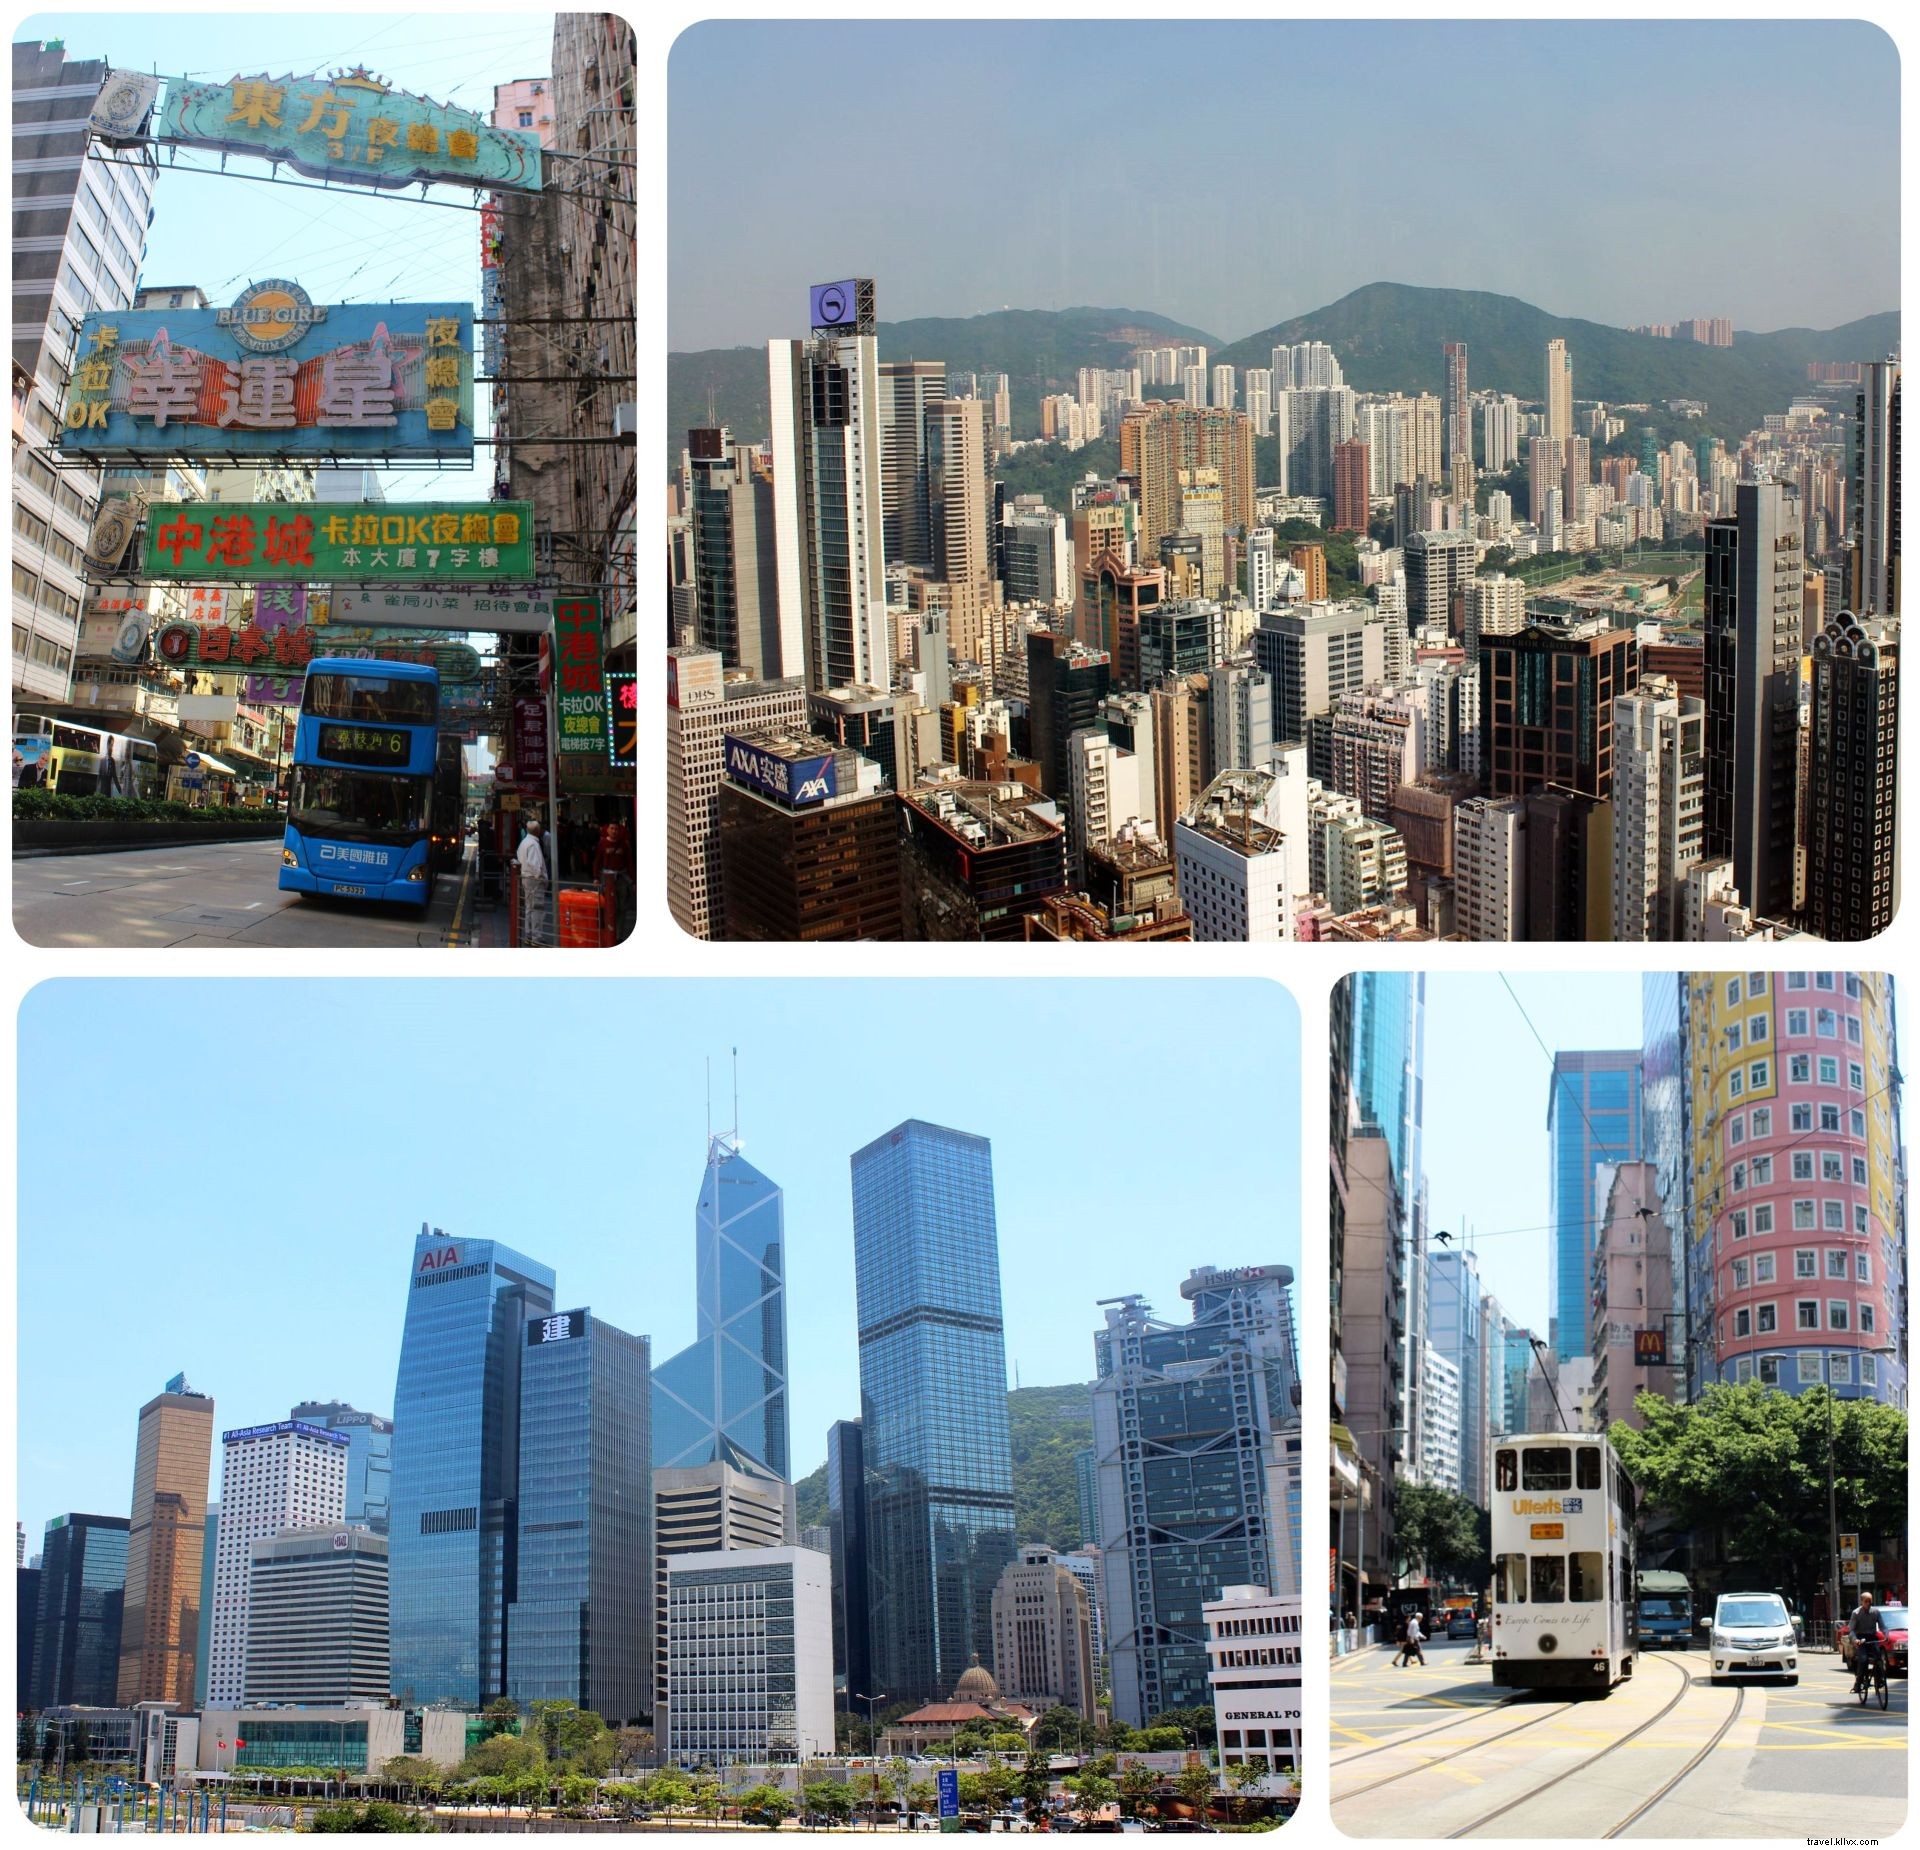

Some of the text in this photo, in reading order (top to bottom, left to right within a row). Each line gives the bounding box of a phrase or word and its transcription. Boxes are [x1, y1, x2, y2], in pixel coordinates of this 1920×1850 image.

[224, 81, 356, 139] 東方
[216, 305, 329, 326] BLUE GIRL
[66, 325, 120, 430] 卡拉OK
[424, 317, 461, 431] 夜總會
[321, 513, 520, 545] 卡拉OK夜總會
[158, 513, 316, 567] 中港城
[473, 598, 550, 615] 招待會員
[197, 622, 316, 666] 日本城
[558, 602, 601, 693] 中港城
[559, 696, 604, 714] 卡拉OK
[688, 689, 715, 703] DBS
[564, 716, 601, 734] 夜總會
[390, 734, 401, 752] 6
[560, 737, 606, 751] 電梯按7字
[731, 746, 760, 778] AXA
[795, 778, 829, 800] AXA
[337, 847, 389, 866] 美國雅培
[420, 1246, 458, 1271] AIA
[1204, 1270, 1242, 1285] HSBC
[542, 1315, 570, 1342] 建
[252, 1422, 277, 1435] Research
[278, 1420, 293, 1431] Team
[336, 1415, 367, 1425] LIPPO
[371, 1415, 385, 1431] LIPPO
[320, 1427, 339, 1440] Research
[339, 1432, 351, 1443] Team
[1505, 1615, 1531, 1633] Europe
[1533, 1614, 1559, 1625] Comes
[1560, 1616, 1569, 1624] to
[1593, 1662, 1605, 1672] 46
[1225, 1710, 1282, 1720] GENERAL
